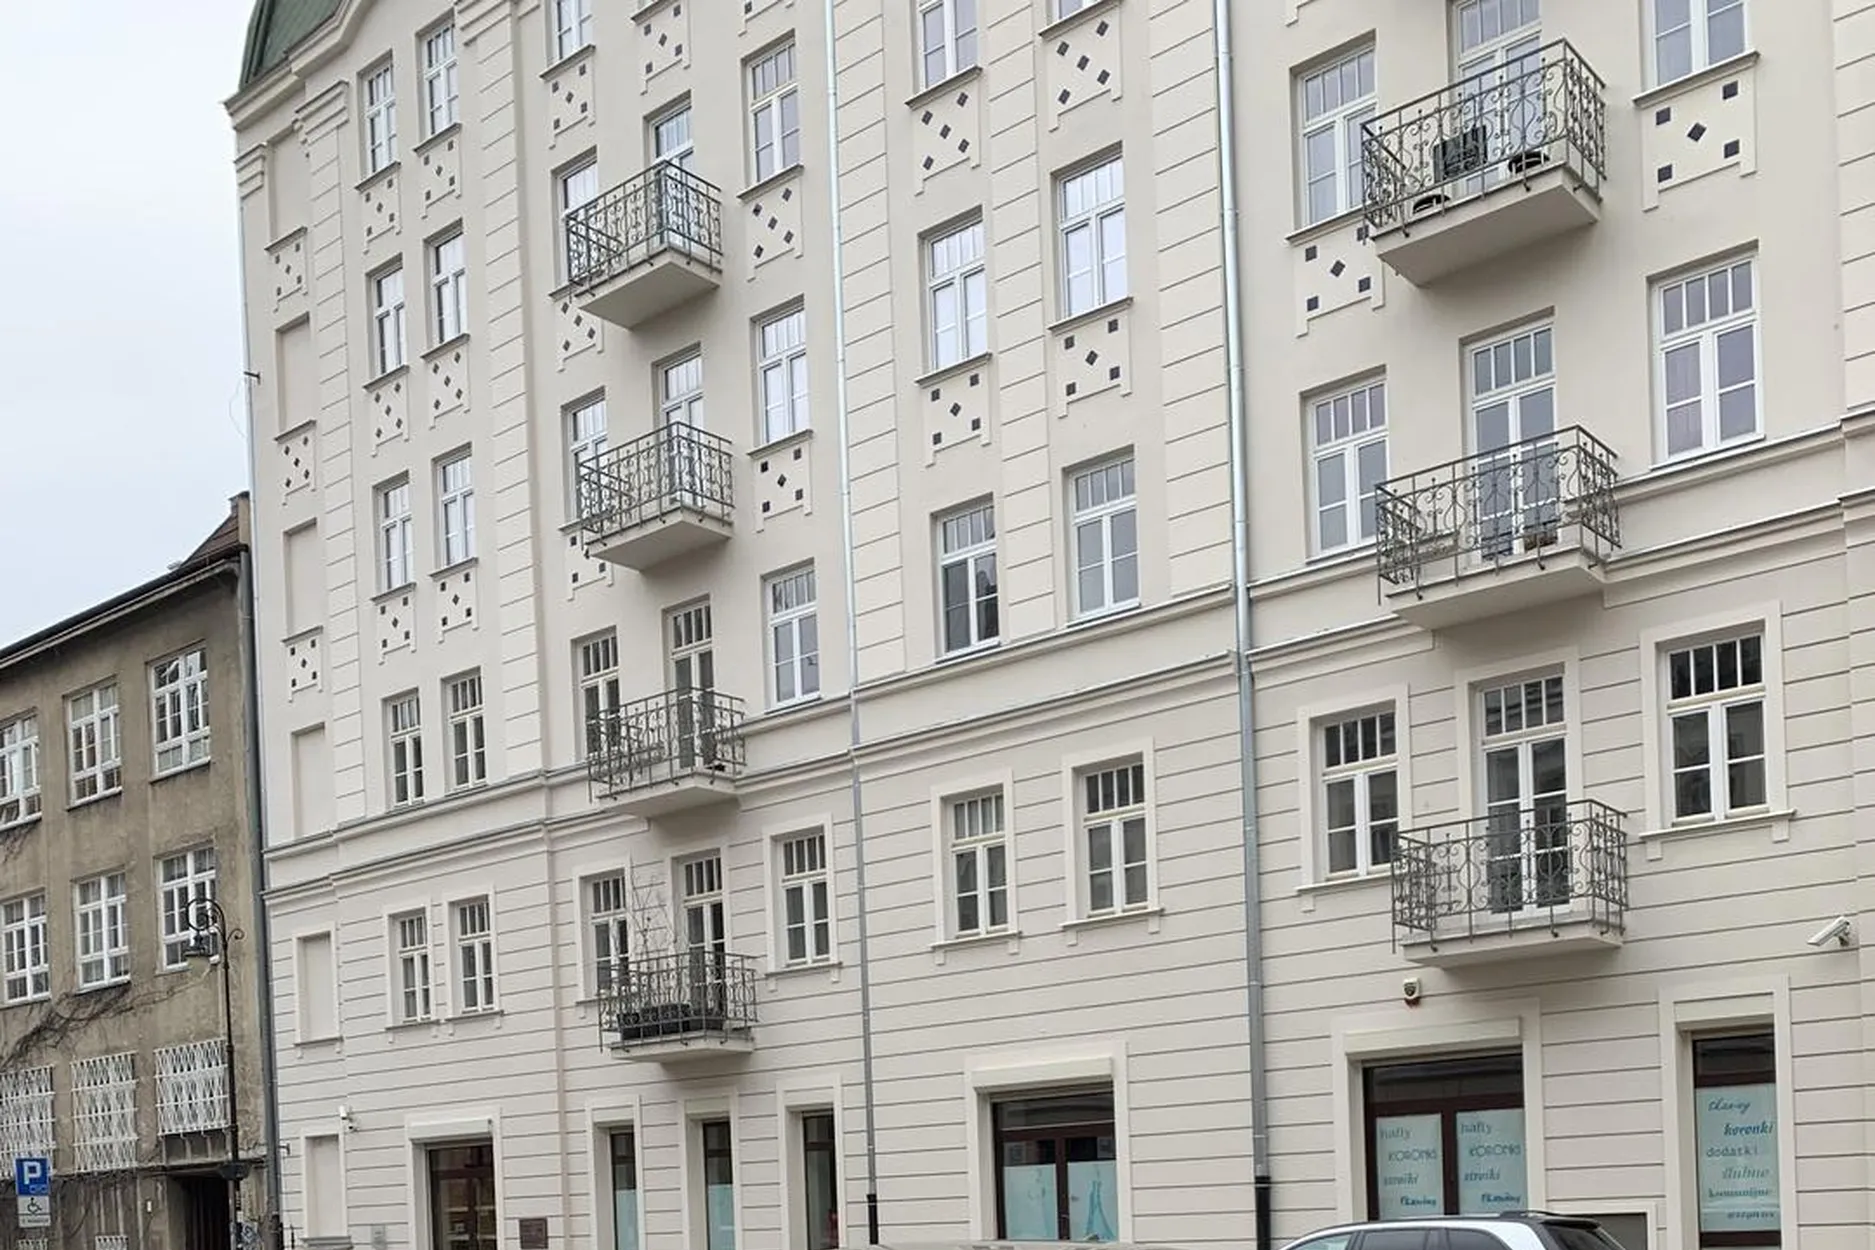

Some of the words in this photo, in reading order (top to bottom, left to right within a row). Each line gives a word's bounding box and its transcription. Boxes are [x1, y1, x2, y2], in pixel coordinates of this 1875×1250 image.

[1723, 1121, 1774, 1136] koronki
[1706, 1146, 1758, 1158] dodatki
[23, 1161, 42, 1185] P
